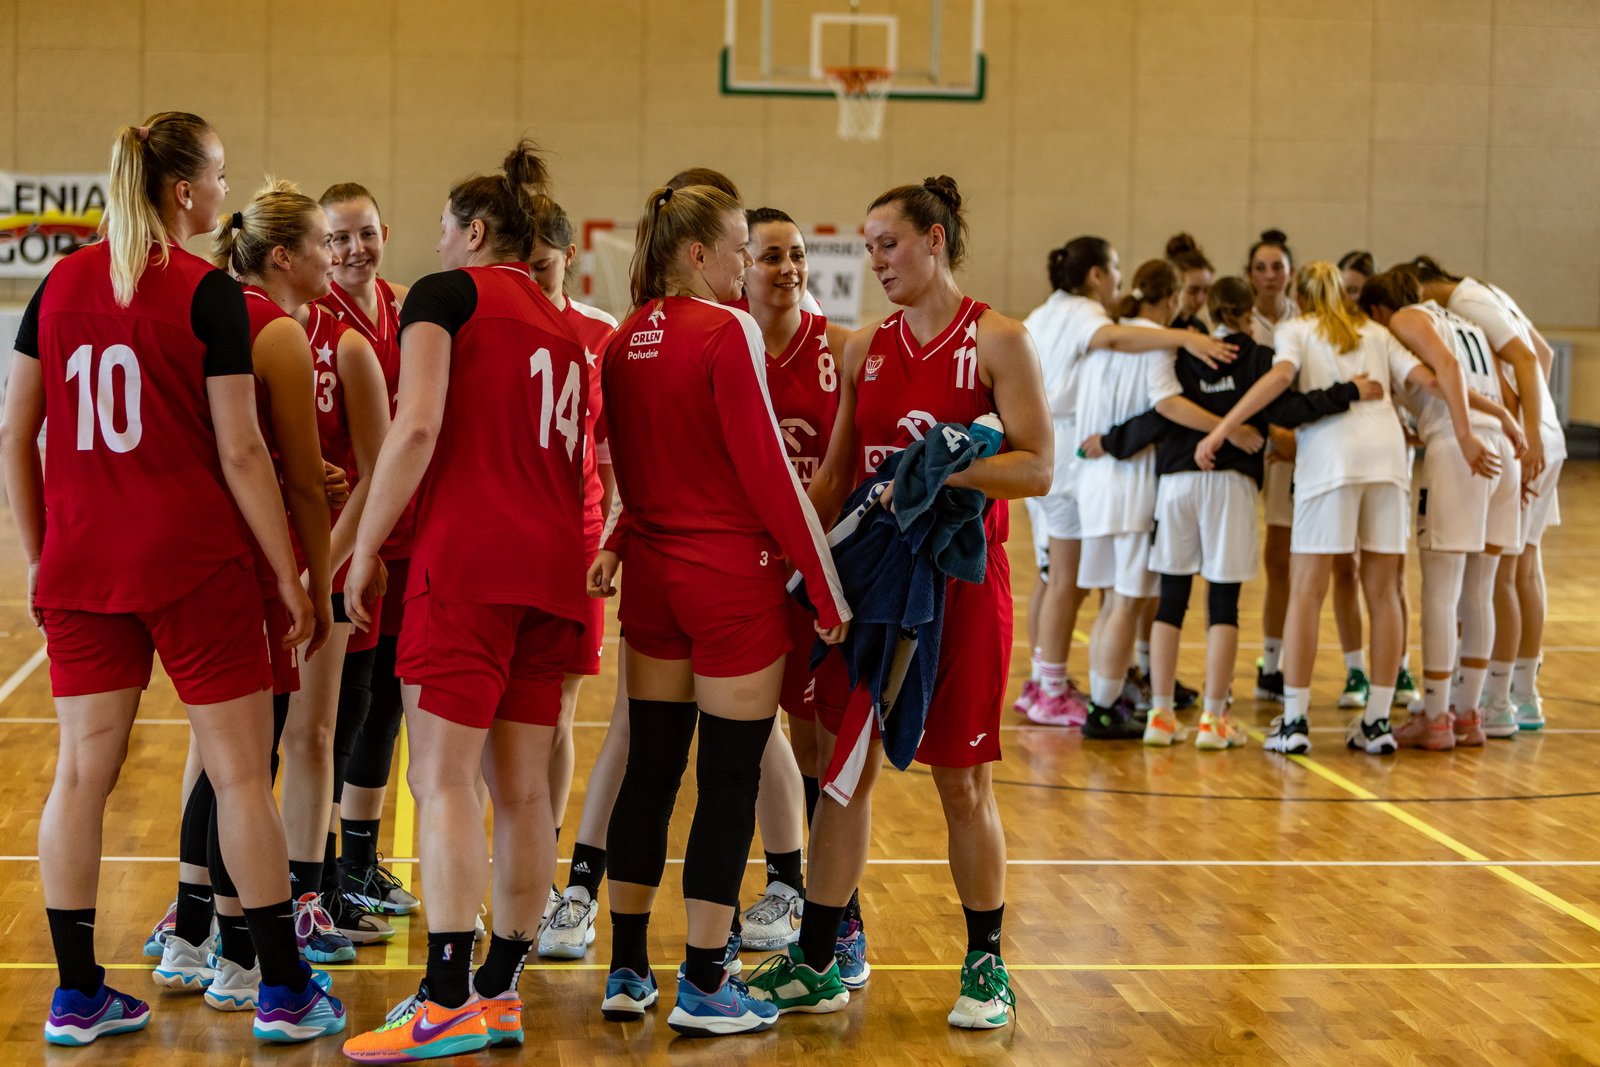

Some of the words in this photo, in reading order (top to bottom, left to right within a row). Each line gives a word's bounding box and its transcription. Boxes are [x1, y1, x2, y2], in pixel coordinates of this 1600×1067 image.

[632, 332, 661, 344] ORLEN
[1456, 329, 1489, 376] 11
[817, 352, 837, 393] 8
[953, 345, 978, 390] 11
[65, 343, 143, 453] 10
[529, 347, 581, 463] 14
[759, 550, 769, 567] 3
